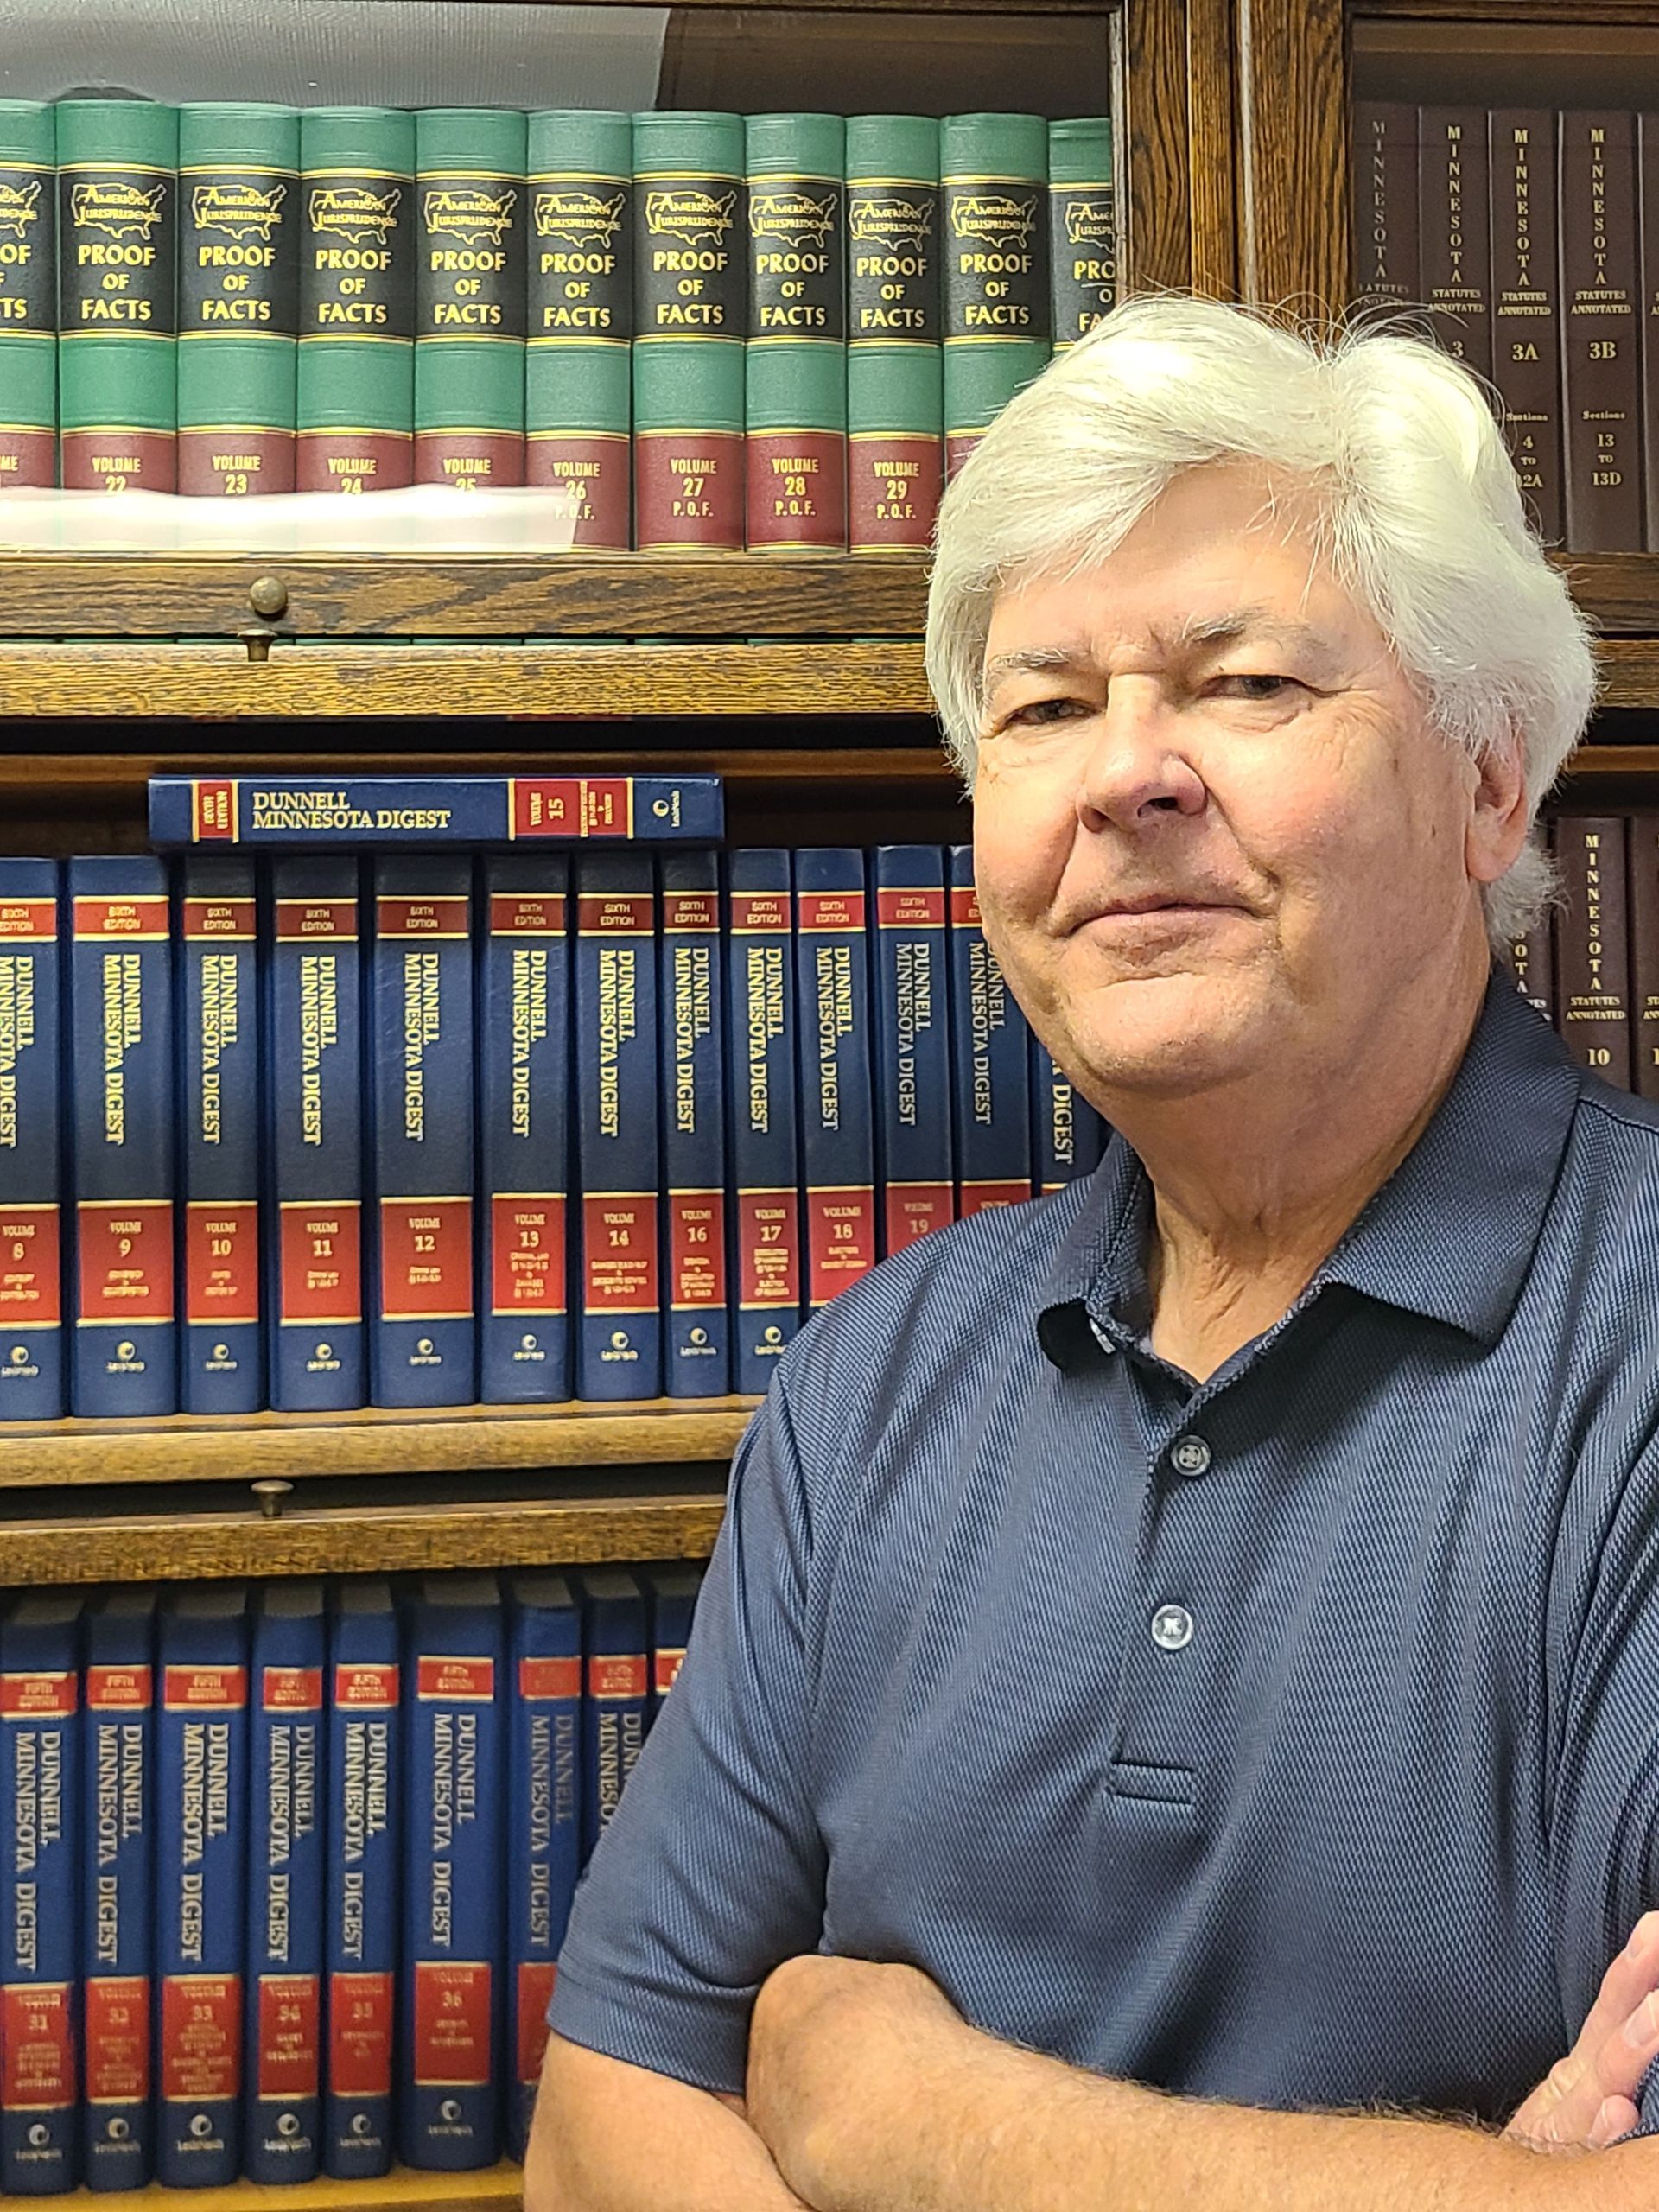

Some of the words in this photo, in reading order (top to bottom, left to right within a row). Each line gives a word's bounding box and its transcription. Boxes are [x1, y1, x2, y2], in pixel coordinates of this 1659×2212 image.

[1447, 125, 1464, 283] MINNESOTA
[1514, 129, 1530, 287] MINNESOTA
[1590, 128, 1607, 285] MINNESOTA
[78, 244, 156, 266] PROOF
[198, 245, 276, 268] PROOF
[315, 249, 392, 271] PROOF
[430, 250, 507, 272] PROOF
[540, 253, 616, 275] PROOF
[653, 251, 728, 273] PROOF
[755, 252, 830, 275] PROOF
[959, 253, 1032, 276] PROOF
[855, 256, 928, 277] PROOF
[1073, 260, 1115, 280] PRO
[102, 273, 130, 290] OF
[223, 273, 250, 292] OF
[339, 276, 366, 295] OF
[454, 276, 482, 296] OF
[564, 280, 591, 298] OF
[677, 278, 704, 296] OF
[780, 281, 805, 298] OF
[880, 283, 905, 301] OF
[985, 282, 1009, 299] OF
[1432, 289, 1482, 299] STATUTES
[1502, 291, 1548, 302] STATUTES
[1575, 289, 1627, 300] STATUTES
[81, 299, 152, 321] FACTS
[201, 300, 271, 321] FACTS
[317, 302, 388, 324] FACTS
[433, 303, 502, 325] FACTS
[543, 306, 611, 327] FACTS
[656, 304, 724, 326] FACTS
[760, 306, 826, 327] FACTS
[860, 308, 925, 329] FACTS
[965, 306, 1029, 327] FACTS
[1497, 306, 1552, 316] ANNOTATED
[1571, 304, 1632, 315] ANNOTATED
[1512, 343, 1540, 361] 3A
[1589, 342, 1617, 359] 3B
[1582, 410, 1625, 420] Sections
[1522, 435, 1534, 449] 4
[1597, 434, 1615, 448] 13
[92, 455, 141, 474] VOLUME
[213, 454, 261, 473] VOLUME
[328, 457, 377, 476] VOLUME
[442, 457, 491, 476] VOLUME
[553, 460, 601, 478] VOLUME
[670, 457, 717, 475] VOLUME
[772, 458, 819, 476] VOLUME
[874, 461, 920, 479] VOLUME
[1598, 454, 1614, 464] TO
[225, 474, 248, 495] 23
[340, 477, 363, 496] 24
[683, 478, 704, 498] 27
[785, 478, 806, 498] 28
[1516, 473, 1544, 488] 2A
[1592, 472, 1622, 486] 13D
[565, 480, 587, 501] 26
[886, 480, 907, 501] 29
[673, 498, 714, 518] P.O.F.
[774, 498, 816, 517] P.O.F.
[876, 503, 917, 521] P.O.F.
[253, 792, 351, 810] DUNNELL
[548, 798, 565, 820] 15
[252, 810, 374, 829] MINNESOTA
[377, 810, 451, 829] DIGEST
[1586, 835, 1603, 991] MINNESOTA
[531, 950, 547, 1042] DUNNELL
[619, 950, 635, 1042] DUNNELL
[692, 948, 710, 1039] DUNNELL
[766, 948, 783, 1039] DUNNELL
[834, 947, 852, 1036] DUNNELL
[914, 942, 931, 1032] DUNNELL
[969, 942, 988, 1052] MINNESOTA
[123, 954, 142, 1050] DUNNELL
[219, 954, 238, 1049] DUNNELL
[319, 955, 337, 1050] DUNNELL
[422, 953, 440, 1046] DUNNELL
[512, 950, 529, 1064] MINNESOTA
[600, 950, 617, 1065] MINNESOTA
[675, 948, 692, 1061] MINNESOTA
[747, 948, 766, 1059] MINNESOTA
[817, 947, 837, 1058] MINNESOTA
[896, 943, 914, 1054] MINNESOTA
[1571, 997, 1620, 1006] STATUTES
[103, 954, 123, 1071] MINNESOTA
[201, 954, 219, 1071] MINNESOTA
[301, 955, 320, 1071] MINNESOTA
[404, 953, 423, 1067] MINNESOTA
[1567, 1010, 1626, 1020] ANNOTATED
[1588, 1049, 1610, 1065] 10
[677, 1063, 694, 1134] DIGEST
[750, 1064, 768, 1134] DIGEST
[820, 1062, 839, 1131] DIGEST
[898, 1057, 915, 1126] DIGEST
[974, 1056, 991, 1124] DIGEST
[105, 1072, 124, 1147] DIGEST
[202, 1072, 220, 1145] DIGEST
[303, 1072, 322, 1147] DIGEST
[405, 1070, 424, 1141] DIGEST
[512, 1066, 529, 1137] DIGEST
[601, 1066, 618, 1137] DIGEST
[688, 1226, 707, 1243] 16
[761, 1225, 781, 1242] 17
[833, 1224, 853, 1240] 18
[911, 1219, 928, 1234] 19
[119, 1239, 131, 1256] 9
[211, 1239, 232, 1255] 10
[313, 1240, 332, 1255] 11
[415, 1235, 435, 1253] 12
[520, 1230, 539, 1248] 13
[610, 1230, 630, 1247] 14
[13, 1243, 24, 1260] 8
[367, 1722, 387, 1839] DUNNELL
[458, 1715, 476, 1825] DUNNELL
[41, 1732, 60, 1847] DUNNELL
[122, 1725, 143, 1840] DUNNELL
[207, 1724, 229, 1840] DUNNELL
[345, 1723, 365, 1863] MINNESOTA
[435, 1714, 453, 1853] MINNESOTA
[16, 1732, 36, 1873] MINNESOTA
[98, 1725, 118, 1867] MINNESOTA
[182, 1724, 205, 1866] MINNESOTA
[432, 1861, 451, 1948] DIGEST
[98, 1877, 118, 1967] DIGEST
[181, 1874, 202, 1963] DIGEST
[343, 1872, 363, 1961] DIGEST
[16, 1883, 37, 1973] DIGEST
